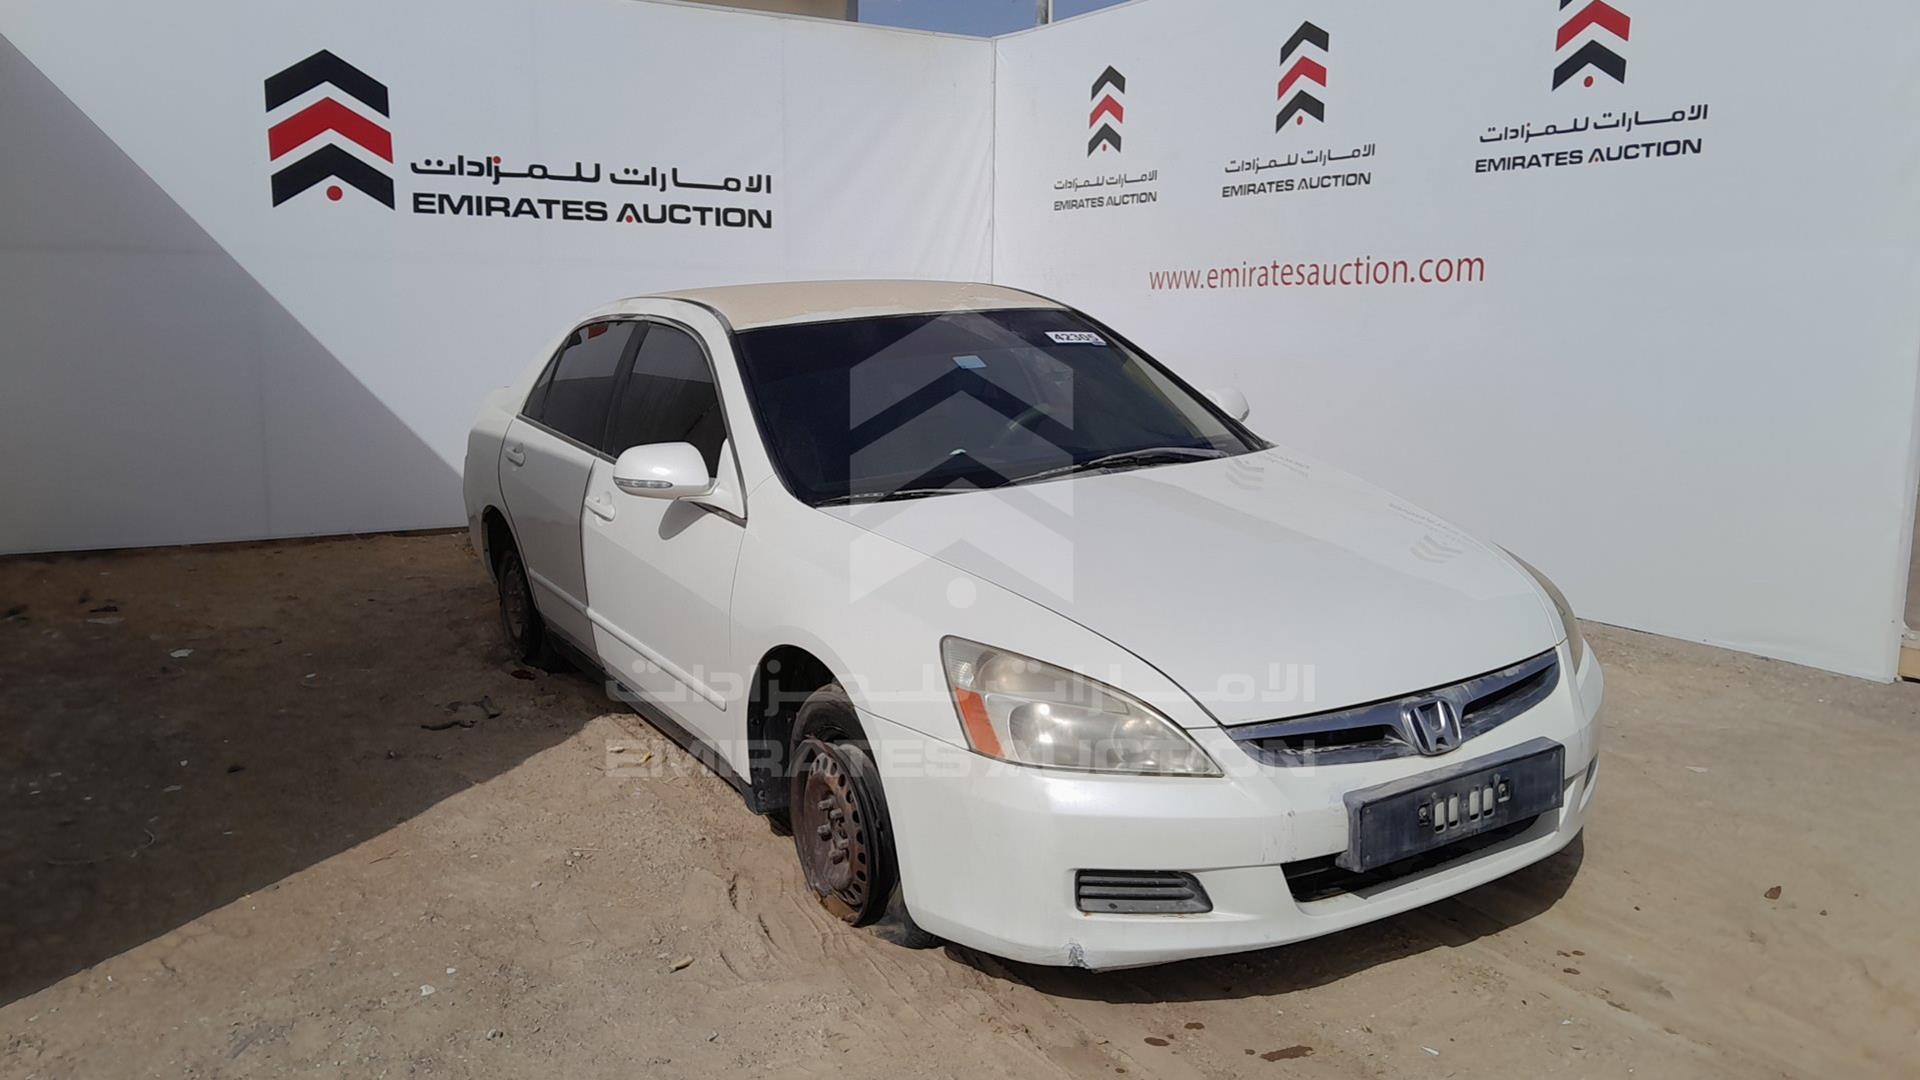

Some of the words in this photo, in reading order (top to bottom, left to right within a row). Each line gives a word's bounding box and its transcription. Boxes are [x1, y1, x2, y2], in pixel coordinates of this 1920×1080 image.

[1475, 149, 1583, 173] EMIRATES
[1588, 138, 1702, 163] AUCTION
[1054, 196, 1104, 211] EMIRATES
[1105, 191, 1157, 207] AUCTION
[1222, 179, 1294, 197] EMIRATES
[1297, 172, 1371, 191] AUCTION
[412, 192, 608, 222] EMIRATES
[616, 202, 773, 229] AUCTION
[1149, 255, 1485, 290] www.emiratesauction.com
